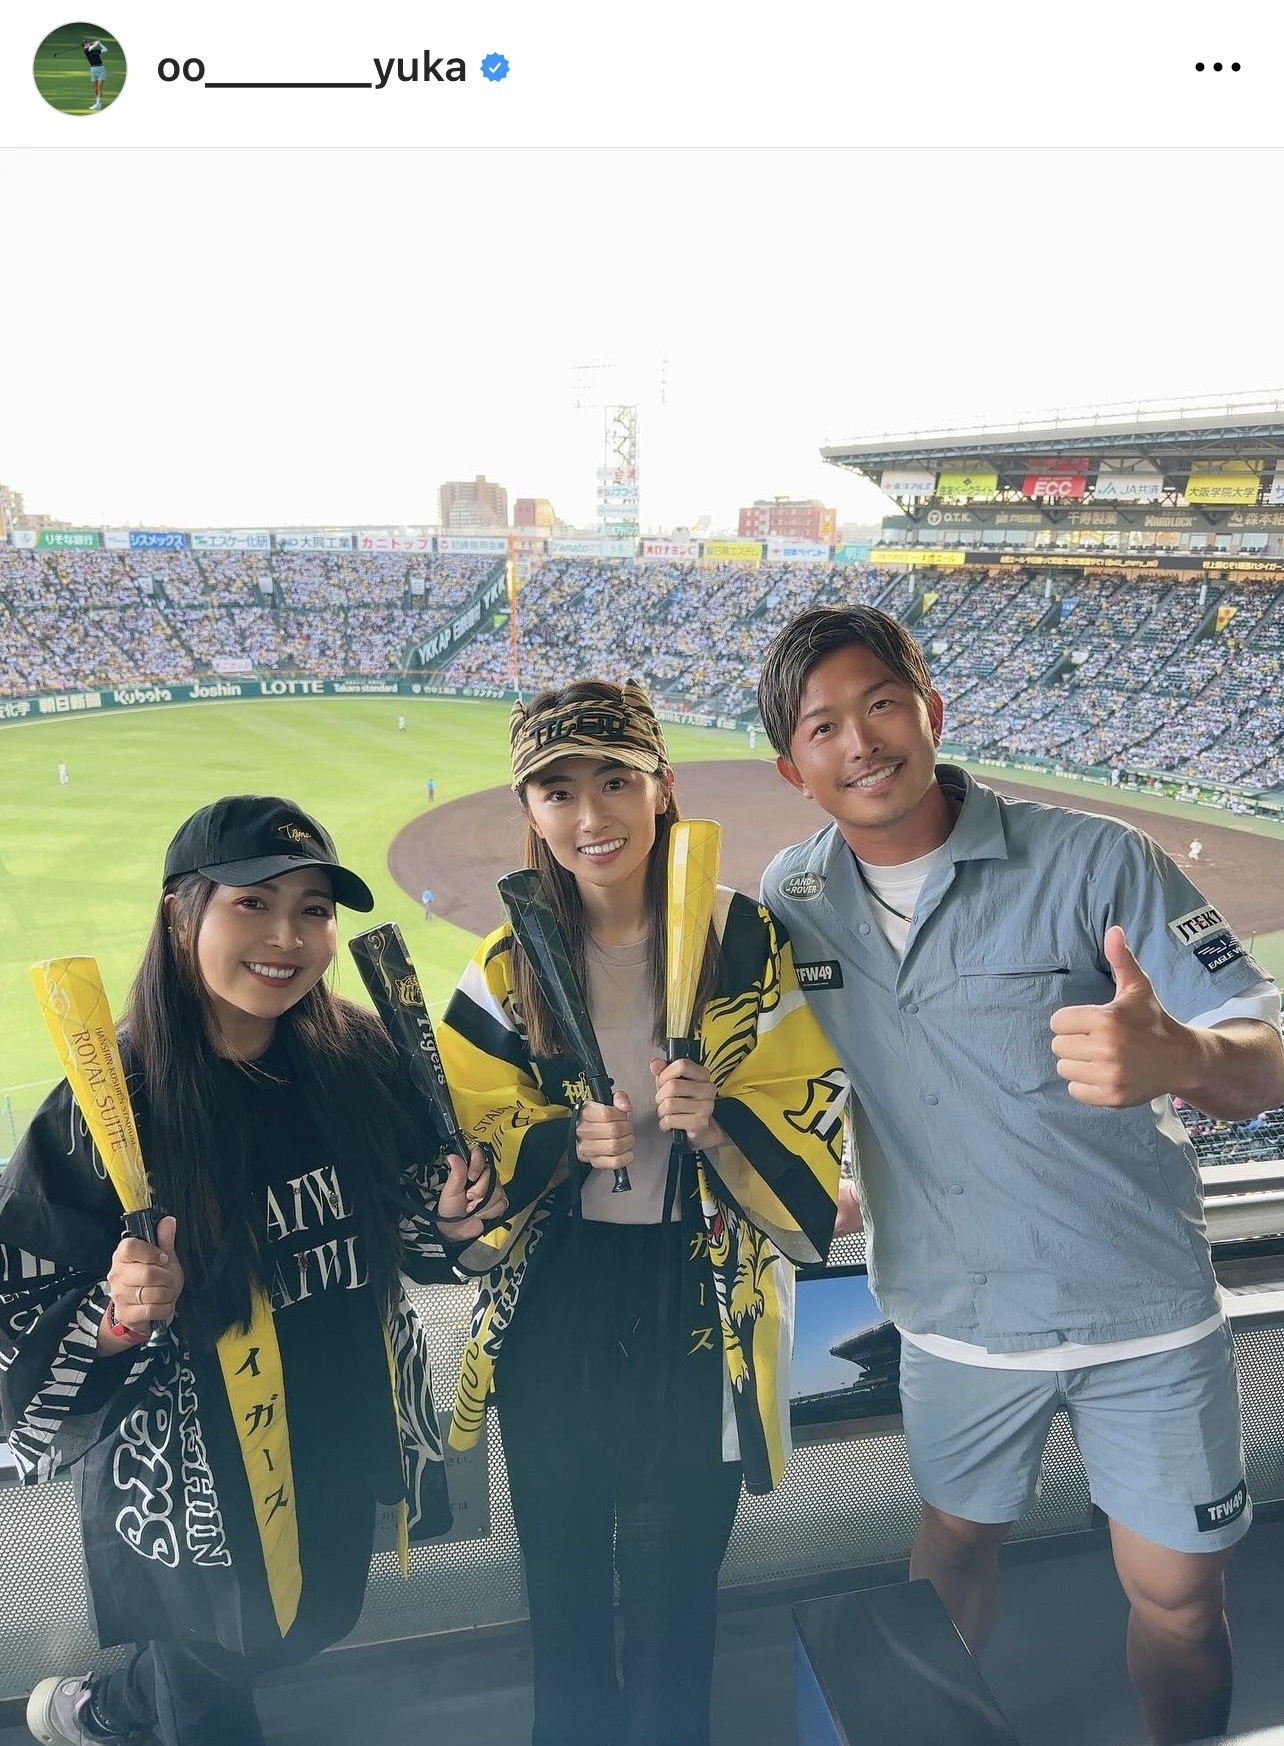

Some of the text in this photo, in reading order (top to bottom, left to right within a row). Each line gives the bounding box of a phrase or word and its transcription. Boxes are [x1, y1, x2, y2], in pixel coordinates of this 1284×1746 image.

[1034, 482, 1073, 495] ECC
[1120, 484, 1160, 495] JA共済
[1189, 486, 1256, 499] 大阪学院大学
[1067, 511, 1118, 525] 千寿製薬
[44, 533, 95, 546] りそな銀行
[130, 532, 184, 548] シスメックス
[208, 535, 269, 548] エスケー化研
[301, 536, 351, 549] 大同工業
[362, 537, 429, 549] カニトップ
[189, 677, 242, 698] Joshin
[260, 679, 325, 695] LOTTE
[38, 692, 102, 714] 朝日新聞
[113, 686, 172, 706] Kubota
[789, 878, 813, 887] LAND
[790, 886, 817, 895] ROVER
[1176, 909, 1223, 943] JTEKT
[1207, 950, 1235, 970] EAGLE
[416, 1012, 447, 1086] Tigers
[72, 1029, 129, 1152] ROYAL SUITE
[1207, 1489, 1243, 1522] TFW49
